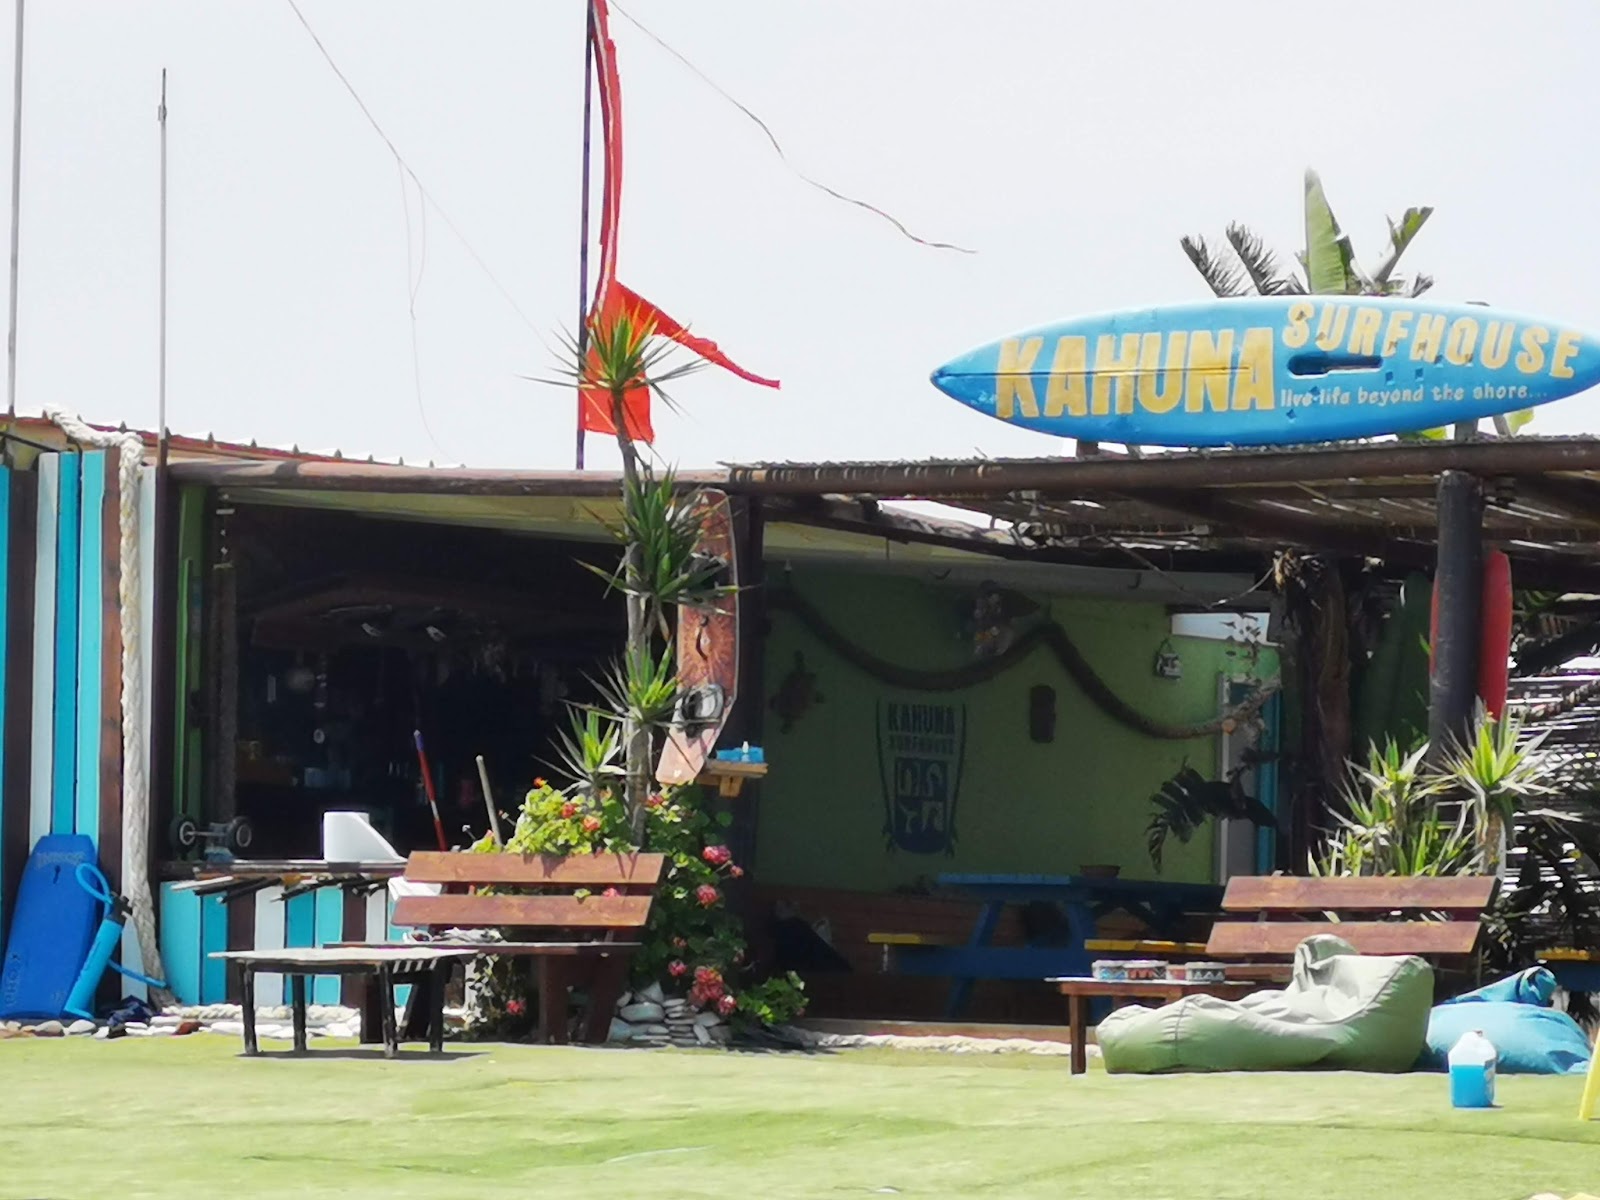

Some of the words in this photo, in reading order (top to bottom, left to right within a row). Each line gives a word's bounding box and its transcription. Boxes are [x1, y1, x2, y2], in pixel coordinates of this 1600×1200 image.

[1281, 302, 1584, 380] SURFHOUSE
[995, 327, 1275, 419] KAHUNA
[1357, 384, 1425, 407] beyond
[1431, 383, 1465, 401] the
[887, 703, 955, 734] KAHUNA
